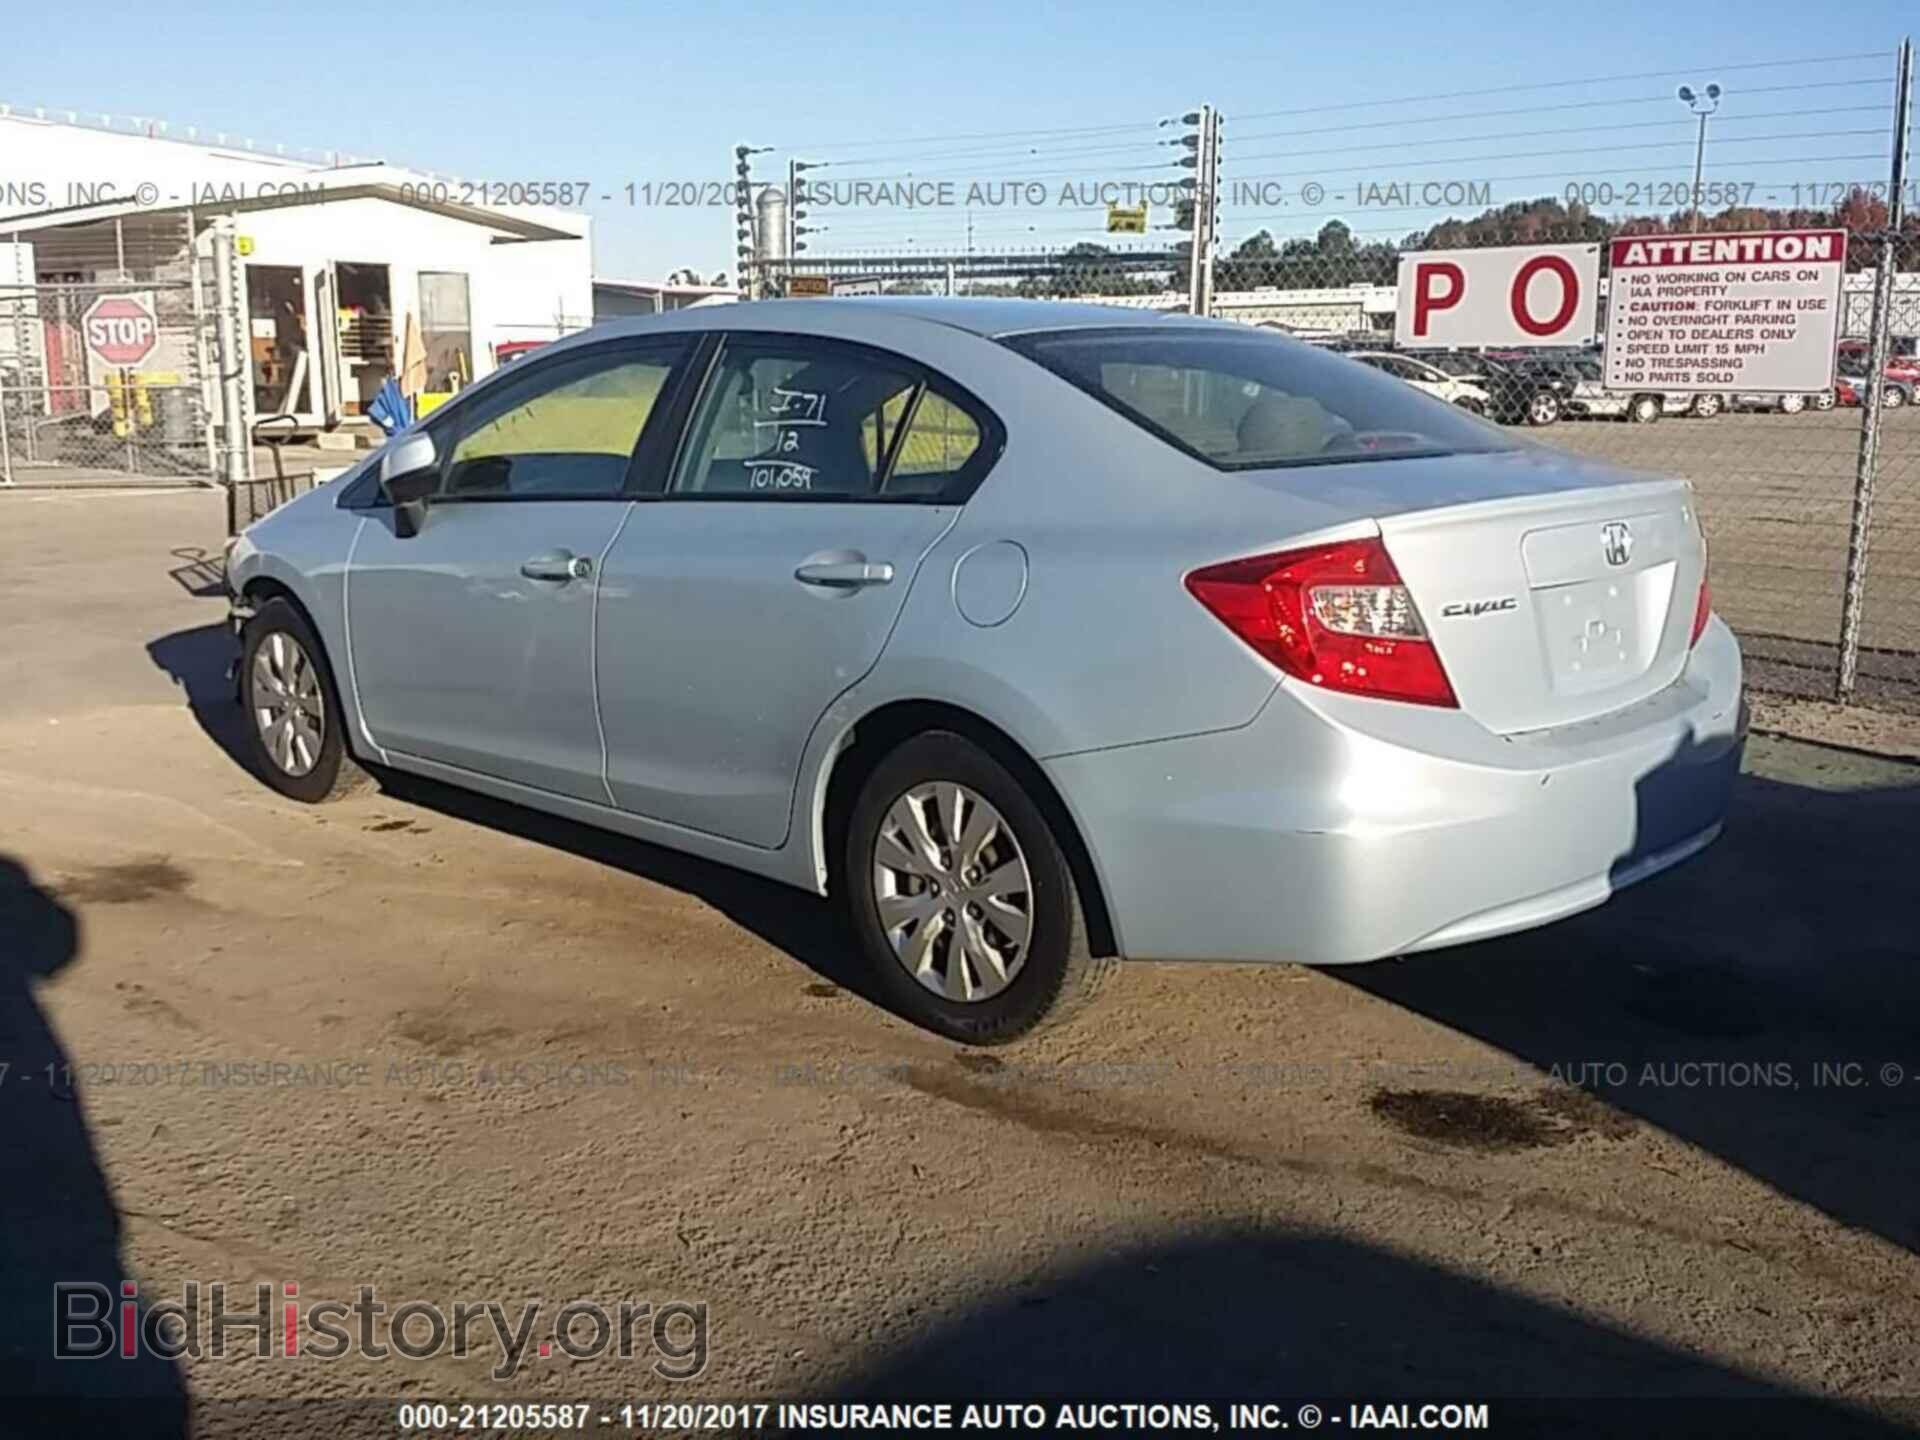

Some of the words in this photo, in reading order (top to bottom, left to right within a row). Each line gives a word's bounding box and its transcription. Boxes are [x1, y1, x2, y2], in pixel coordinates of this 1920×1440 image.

[1622, 236, 1833, 265] ATTENTION
[1630, 274, 1650, 285] NO
[1655, 272, 1720, 284] WORKING
[1724, 271, 1746, 283] ON
[1751, 270, 1791, 283] CARS
[1796, 270, 1819, 282] ON
[1412, 261, 1465, 337] P
[1510, 254, 1580, 336] O
[1630, 287, 1651, 298] IAA
[1656, 285, 1728, 298] PROPERTY
[1704, 299, 1772, 311] FORKLIFT
[1776, 299, 1792, 310] IN
[1796, 298, 1828, 310] USE
[1627, 315, 1648, 326] NO
[1652, 314, 1730, 326] OVERNIGHT
[1734, 313, 1797, 325] PARKING
[89, 317, 152, 346] STOP
[1626, 329, 1663, 340] OPEN
[1668, 328, 1686, 340] TO
[1690, 328, 1754, 340] DEALERS
[1760, 327, 1797, 340] ONLY
[1626, 343, 1670, 355] SPEED
[1674, 343, 1709, 355] LIMIT
[1715, 343, 1729, 355] 15
[1734, 343, 1766, 354] MPH
[1625, 357, 1646, 369] NO
[1651, 357, 1744, 369] TRESPASSING
[1624, 371, 1645, 383] NO
[1650, 371, 1691, 383] PARTS
[1696, 371, 1735, 384] SOLD
[776, 430, 800, 454] 12
